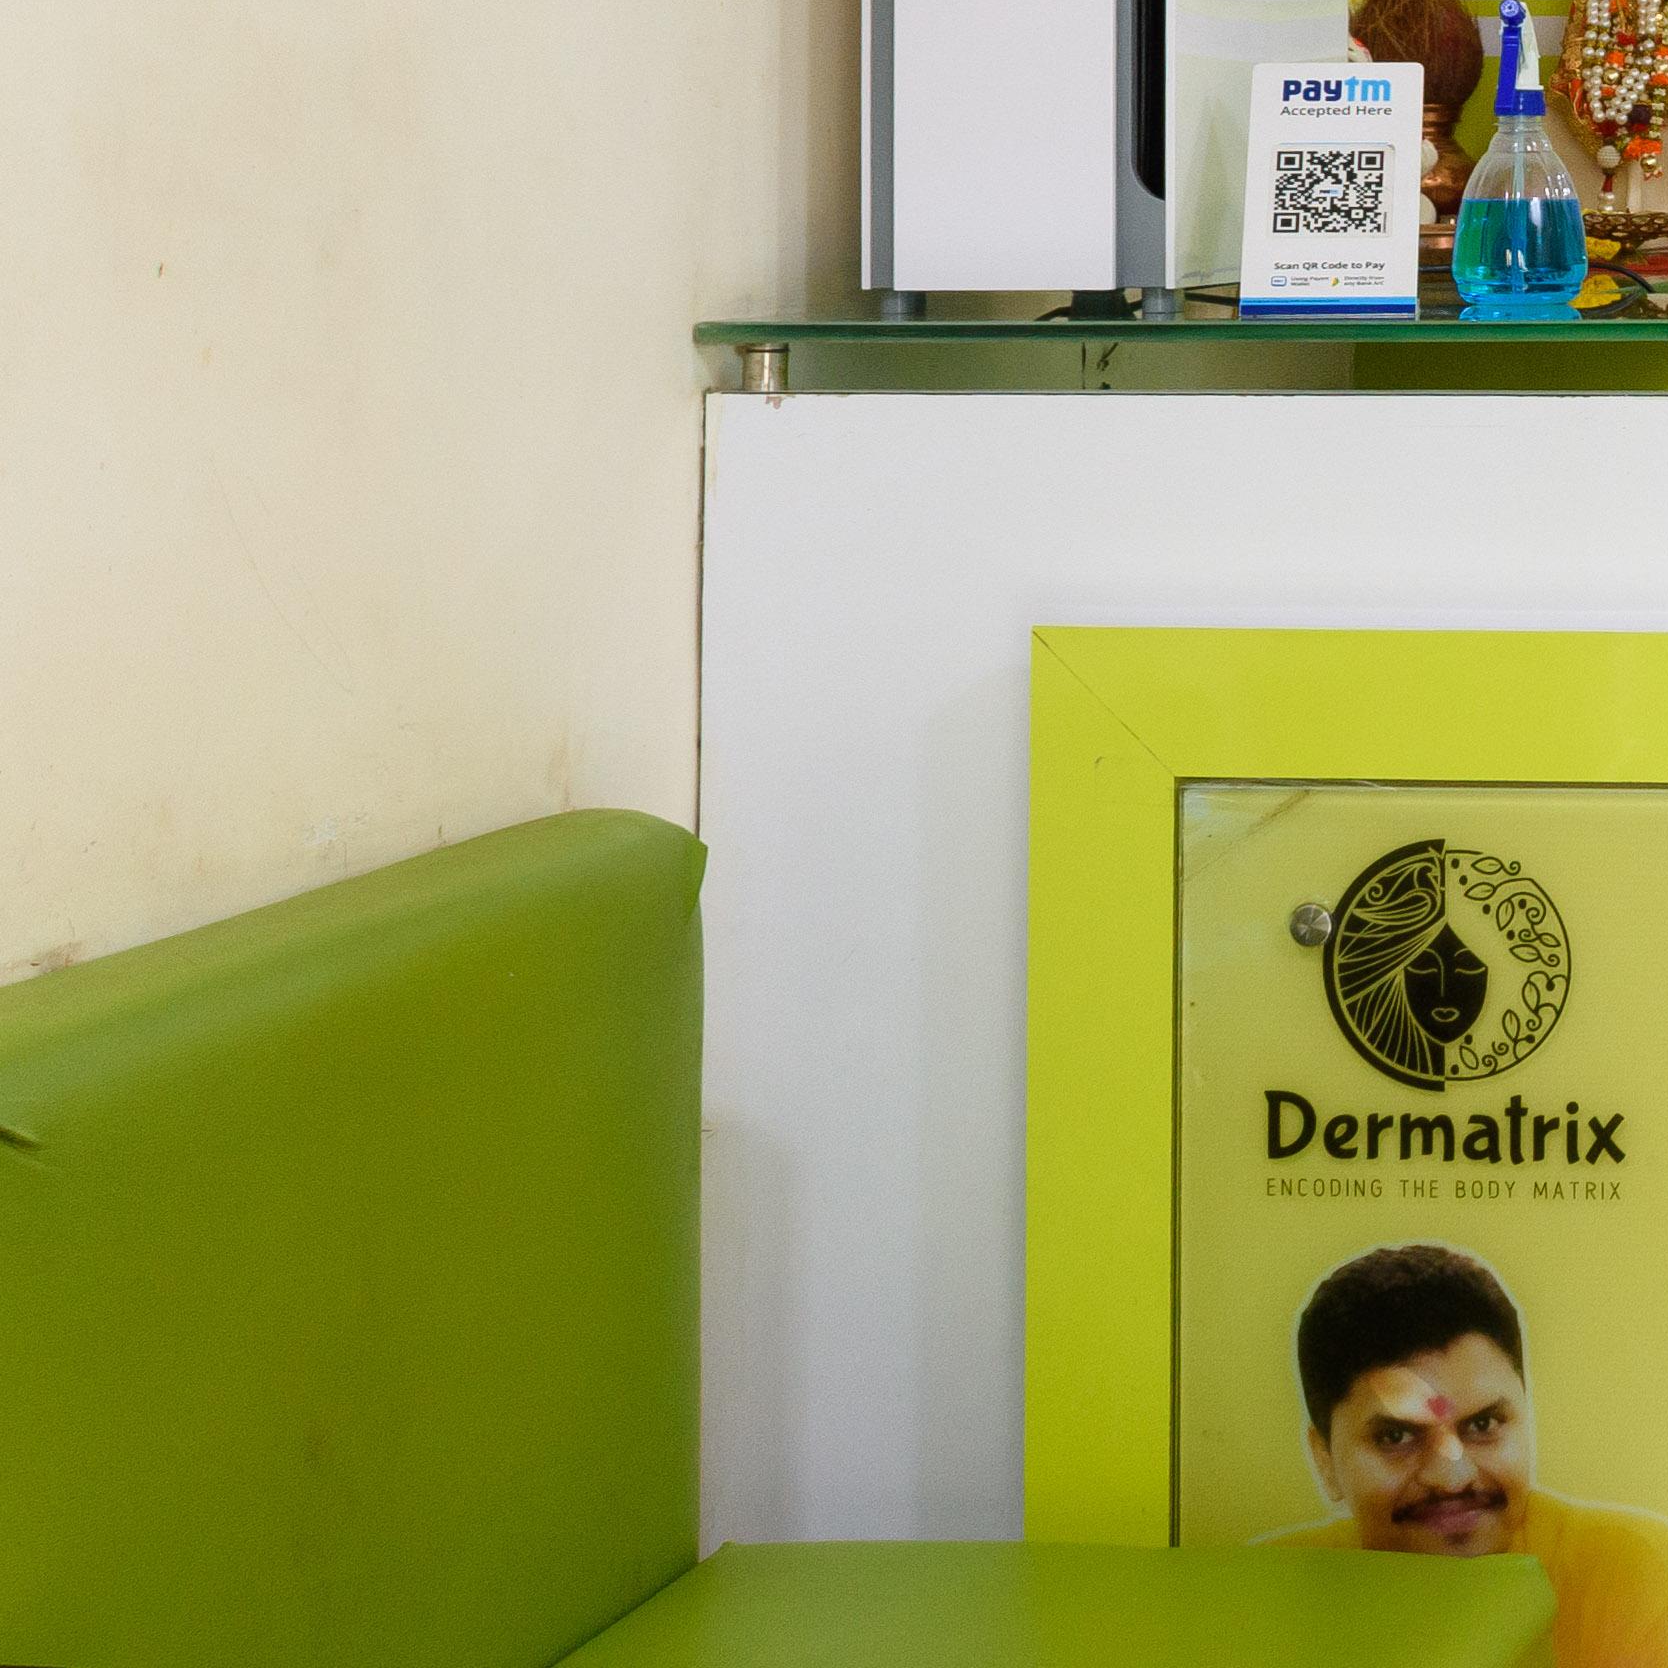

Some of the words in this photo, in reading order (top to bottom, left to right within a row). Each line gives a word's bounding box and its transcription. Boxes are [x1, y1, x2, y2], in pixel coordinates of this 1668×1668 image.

[1280, 106, 1351, 118] Accepted
[1356, 106, 1392, 115] Here
[1275, 262, 1299, 271] Scan
[1302, 261, 1318, 272] QR
[1321, 261, 1348, 270] Code
[1351, 262, 1363, 270] to
[1365, 261, 1385, 271] Pay
[1265, 1091, 1625, 1165] Dermatrix
[1266, 1178, 1382, 1198] ENCODING
[1400, 1179, 1438, 1198] THE
[1455, 1180, 1515, 1199] BODY
[1533, 1181, 1620, 1199] MATRIX
